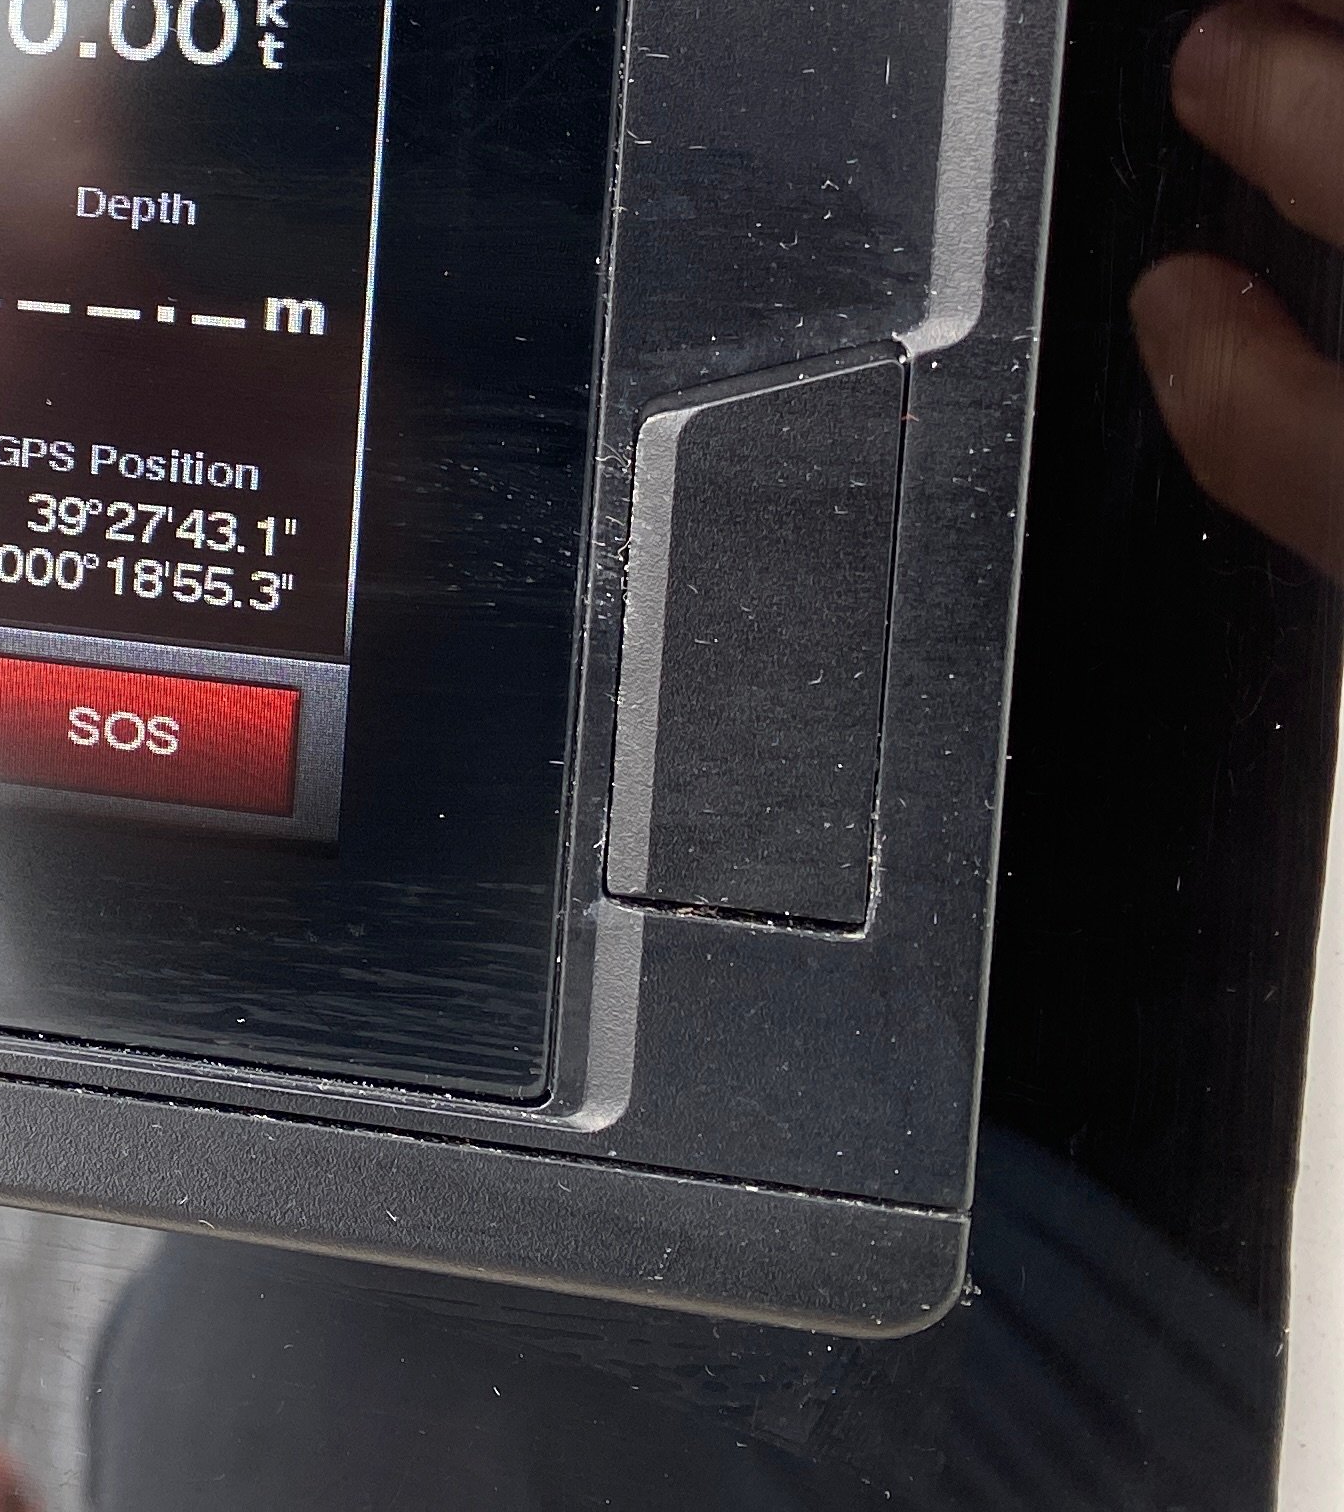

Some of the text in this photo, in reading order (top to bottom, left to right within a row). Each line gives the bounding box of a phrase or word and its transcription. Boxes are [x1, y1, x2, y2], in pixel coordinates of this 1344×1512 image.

[75, 185, 197, 230] Depth
[263, 296, 329, 336] m
[89, 443, 261, 492] Position
[66, 705, 181, 756] SOS
